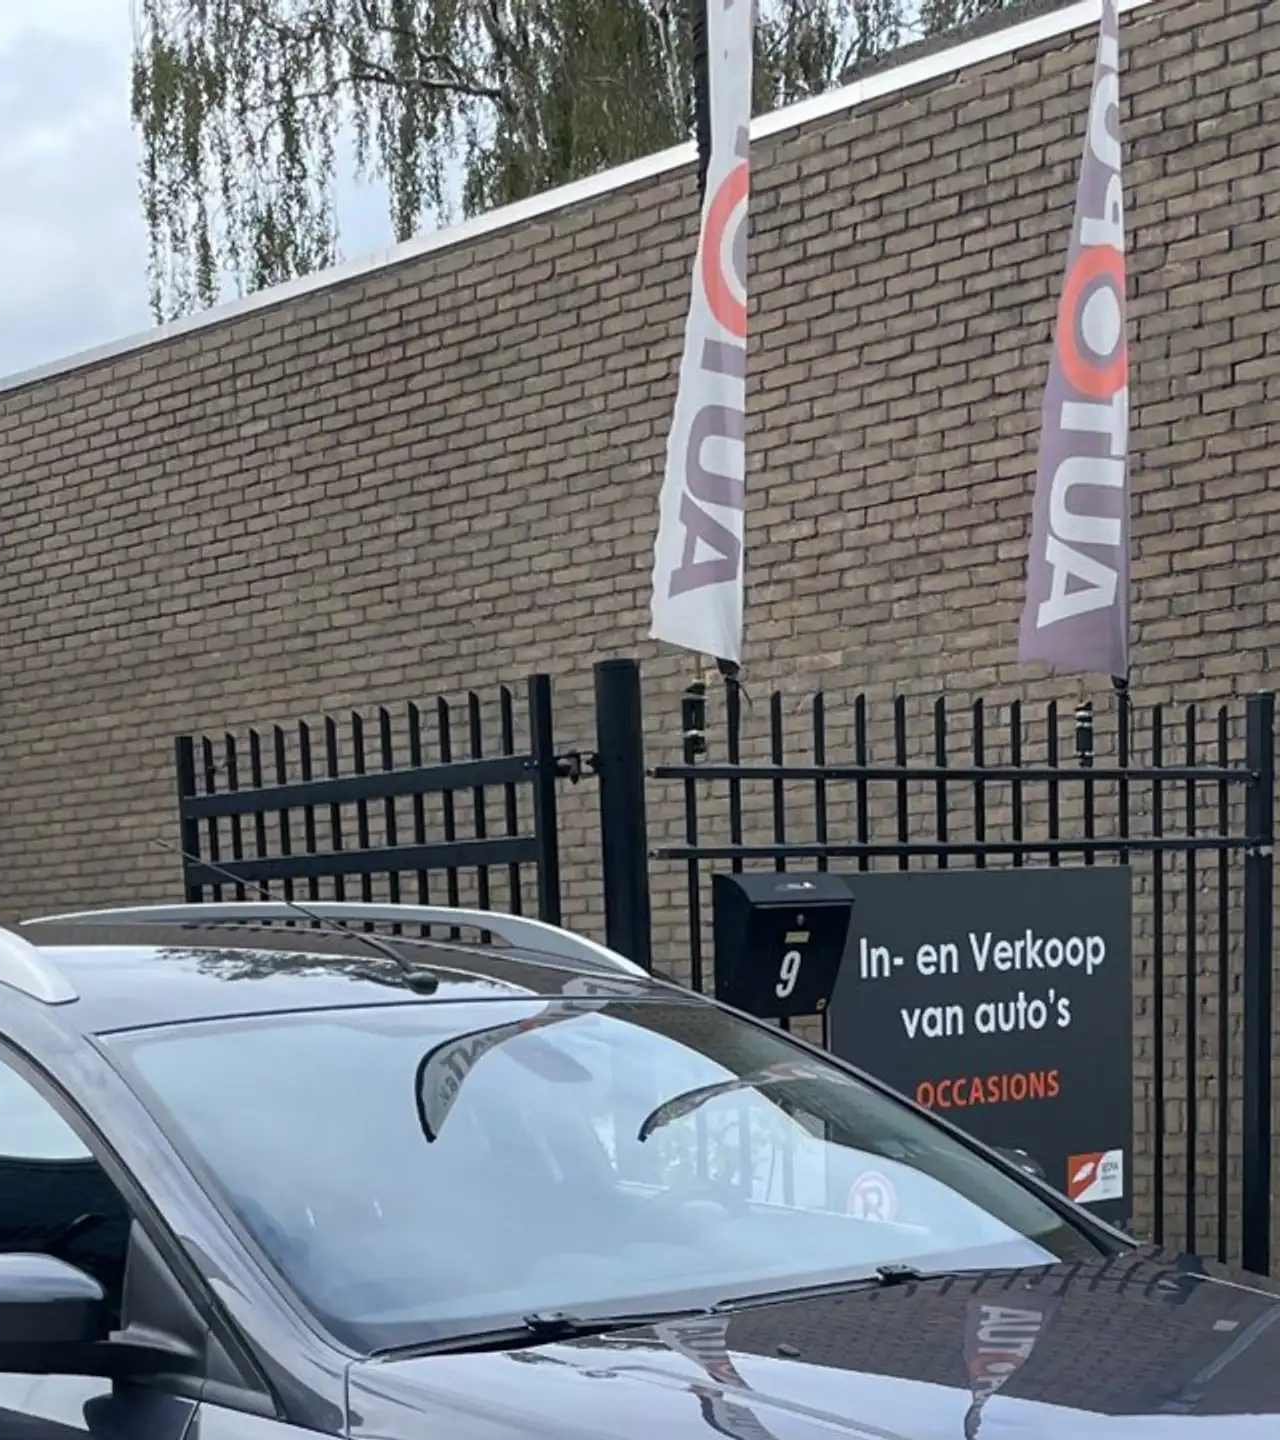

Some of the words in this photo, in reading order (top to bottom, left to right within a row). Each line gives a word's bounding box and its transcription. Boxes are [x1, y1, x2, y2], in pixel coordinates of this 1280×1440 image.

[776, 950, 801, 998] 9
[860, 938, 904, 979] In-
[917, 943, 959, 975] en
[969, 929, 1106, 975] Verkoop
[900, 1004, 964, 1039] van
[974, 988, 1072, 1034] auto's
[916, 1070, 1060, 1109] OCCASIONS
